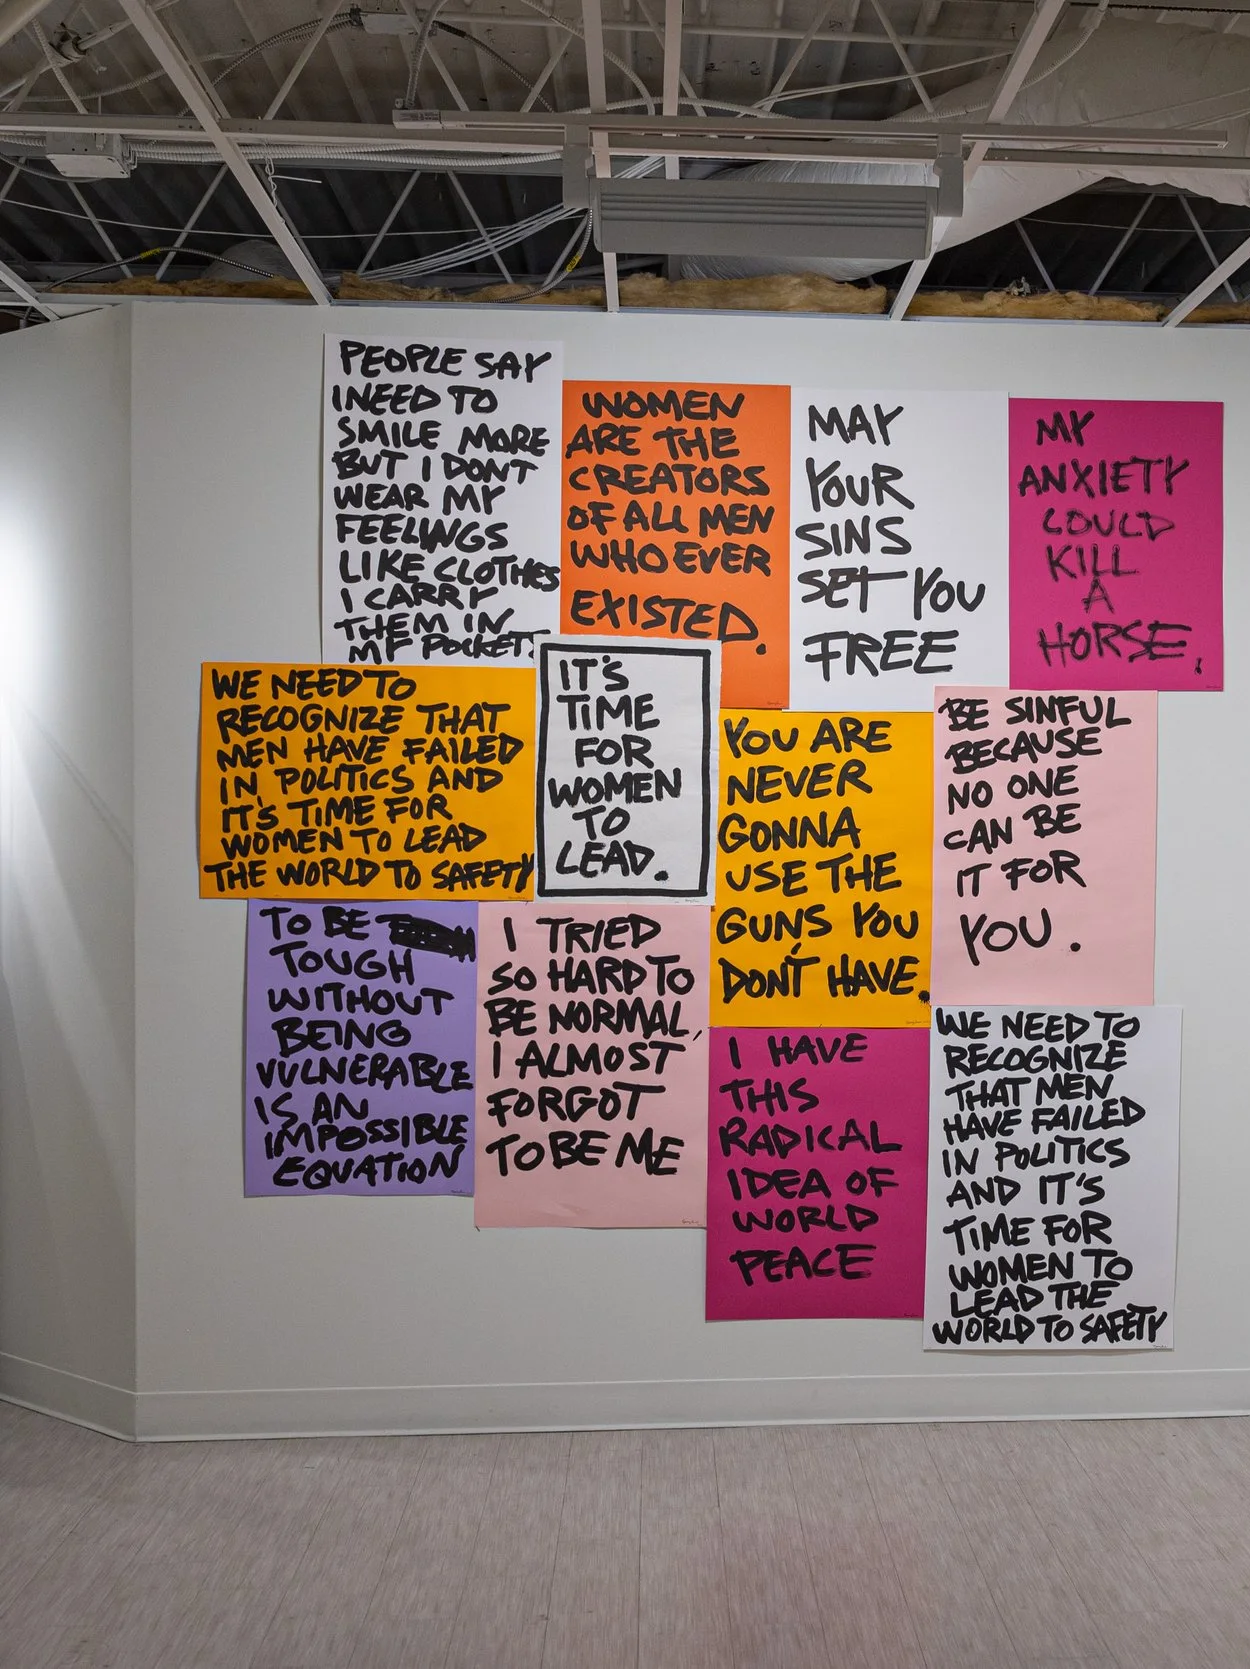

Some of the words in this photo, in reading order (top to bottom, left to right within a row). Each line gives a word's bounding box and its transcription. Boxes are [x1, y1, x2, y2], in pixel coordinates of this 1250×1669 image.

[339, 340, 467, 378] PEOPLE
[474, 352, 551, 382] SAY
[582, 390, 745, 421] WOMEN
[808, 403, 904, 446] MAY
[338, 416, 441, 449] SMILE
[458, 423, 550, 456] MORE
[565, 423, 641, 458] ARE
[653, 427, 740, 461] THE
[1036, 410, 1094, 446] MY
[569, 463, 770, 496] CREATORS
[806, 457, 915, 512] YOUR
[1018, 455, 1190, 498] ANXIETY
[334, 483, 429, 511] WEAR
[443, 484, 505, 515] MY
[795, 515, 911, 560] SINS
[1042, 508, 1175, 540] COULD
[339, 549, 425, 583] LIKE
[1047, 543, 1139, 581] KILL
[798, 565, 908, 613] SET
[914, 567, 985, 620] YOU
[1082, 579, 1114, 613] A
[803, 629, 959, 681] FREE
[217, 703, 404, 744] RECOGNIZE
[416, 702, 511, 735] THAT
[556, 693, 660, 731] TIME
[939, 697, 989, 731] BE
[1005, 695, 1132, 728] SINFUL
[217, 736, 287, 772] MEN
[304, 732, 390, 764] HAVE
[402, 733, 524, 765] FAILED
[575, 734, 654, 768] FOR
[724, 717, 798, 758] YOU
[810, 717, 892, 754] ARE
[944, 727, 1102, 775] BECAUSE
[220, 772, 257, 805] IN
[274, 764, 414, 795] POLITICS
[427, 765, 503, 792] AND
[548, 767, 681, 808] WOMEN
[727, 759, 873, 806] NEVER
[948, 781, 993, 815] NO
[1007, 764, 1079, 799] ONE
[287, 795, 375, 826] TIME
[383, 793, 452, 823] FOR
[572, 805, 630, 840] TO
[718, 806, 861, 853] GONNA
[943, 816, 1012, 854] CAN
[1023, 803, 1081, 838] BE
[221, 826, 344, 860] WOMEN
[350, 827, 392, 854] TO
[403, 823, 487, 853] LEAD
[204, 860, 266, 892] THE
[277, 858, 380, 887] WORLD
[384, 860, 421, 890] TO
[725, 861, 808, 896] USE
[816, 852, 902, 893] THE
[504, 917, 516, 951] I
[536, 914, 661, 953] TRIED
[716, 904, 832, 944] GUNS
[853, 902, 918, 939] YOU
[269, 940, 414, 985] TOUGH
[268, 982, 454, 1016] WITHOUT
[272, 1017, 411, 1057] BEING
[936, 1008, 991, 1039] WE
[1002, 1011, 1090, 1043] NEED
[1094, 1011, 1140, 1040] TO
[493, 1041, 501, 1079] I
[515, 1040, 686, 1079] ALMOST
[728, 1036, 741, 1069] I
[768, 1033, 868, 1066] HAVE
[944, 1040, 1127, 1079] RECOGNIZE
[256, 1053, 473, 1093] VULNERABLE
[945, 1077, 1031, 1111] THAT
[1036, 1073, 1114, 1105] MEN
[719, 1078, 819, 1116] THIS
[264, 1113, 468, 1160] IMPOSSIBLE
[719, 1117, 902, 1159] RADICAL
[944, 1108, 1022, 1145] HAVE
[1032, 1096, 1146, 1134] FAILED
[272, 1144, 465, 1190] EQUATION
[943, 1148, 978, 1177] IN
[995, 1135, 1130, 1172] POLITICS
[727, 1168, 831, 1200] IDEA
[846, 1166, 899, 1197] OF
[946, 1175, 1021, 1209] AND
[732, 1204, 878, 1233] WORLD
[943, 1213, 1035, 1255] TIME
[1042, 1210, 1112, 1246] FOR
[730, 1244, 876, 1286] PEACE
[949, 1251, 1074, 1292] WOMEN
[1081, 1248, 1133, 1281] TO
[950, 1284, 1044, 1319] LEAD
[1048, 1281, 1120, 1311] THE
